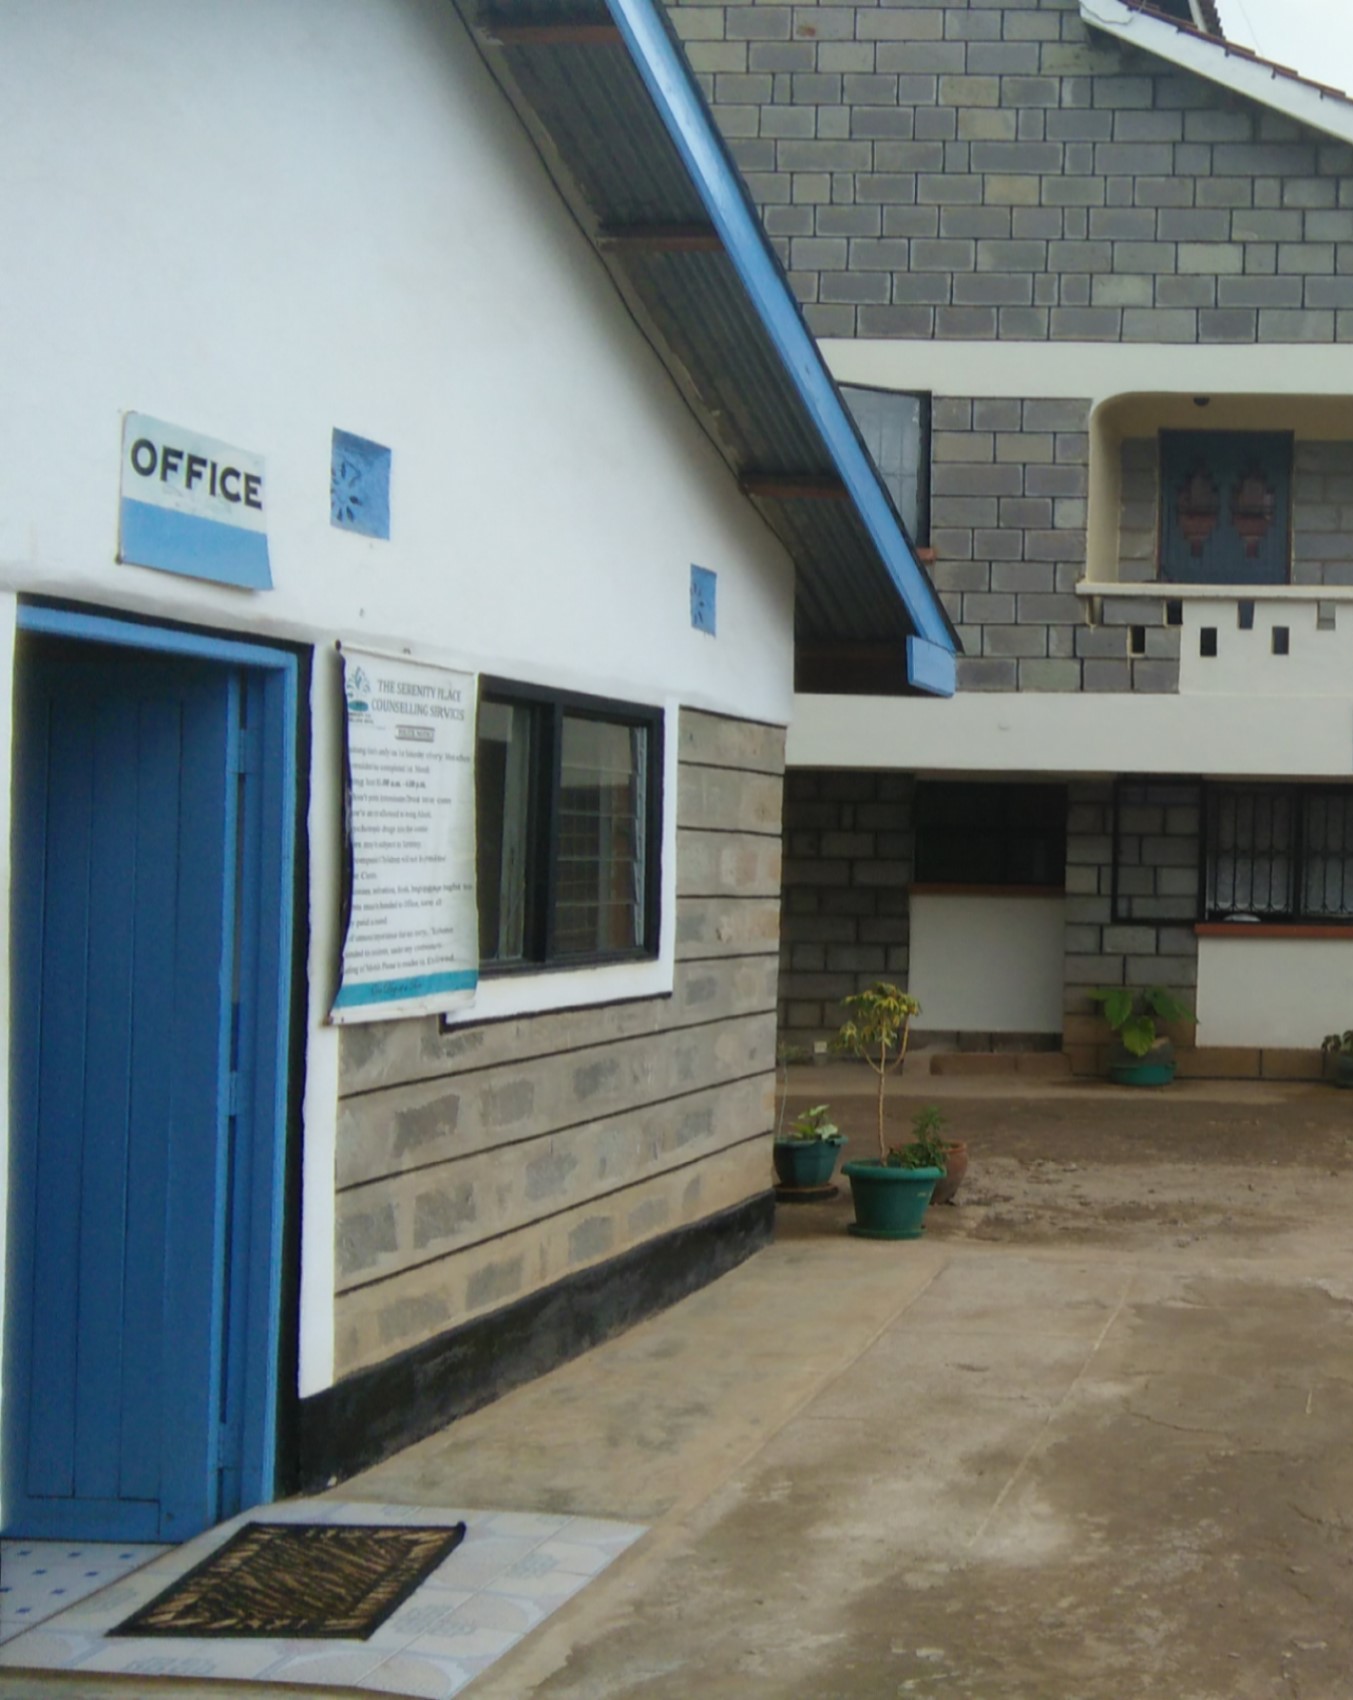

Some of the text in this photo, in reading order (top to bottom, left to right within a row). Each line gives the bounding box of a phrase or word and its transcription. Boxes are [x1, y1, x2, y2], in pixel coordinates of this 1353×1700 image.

[131, 438, 263, 510] OFFICE
[378, 680, 462, 702] THE SERENITY PLACE
[372, 699, 466, 722] COUNSELLING SERVICES
